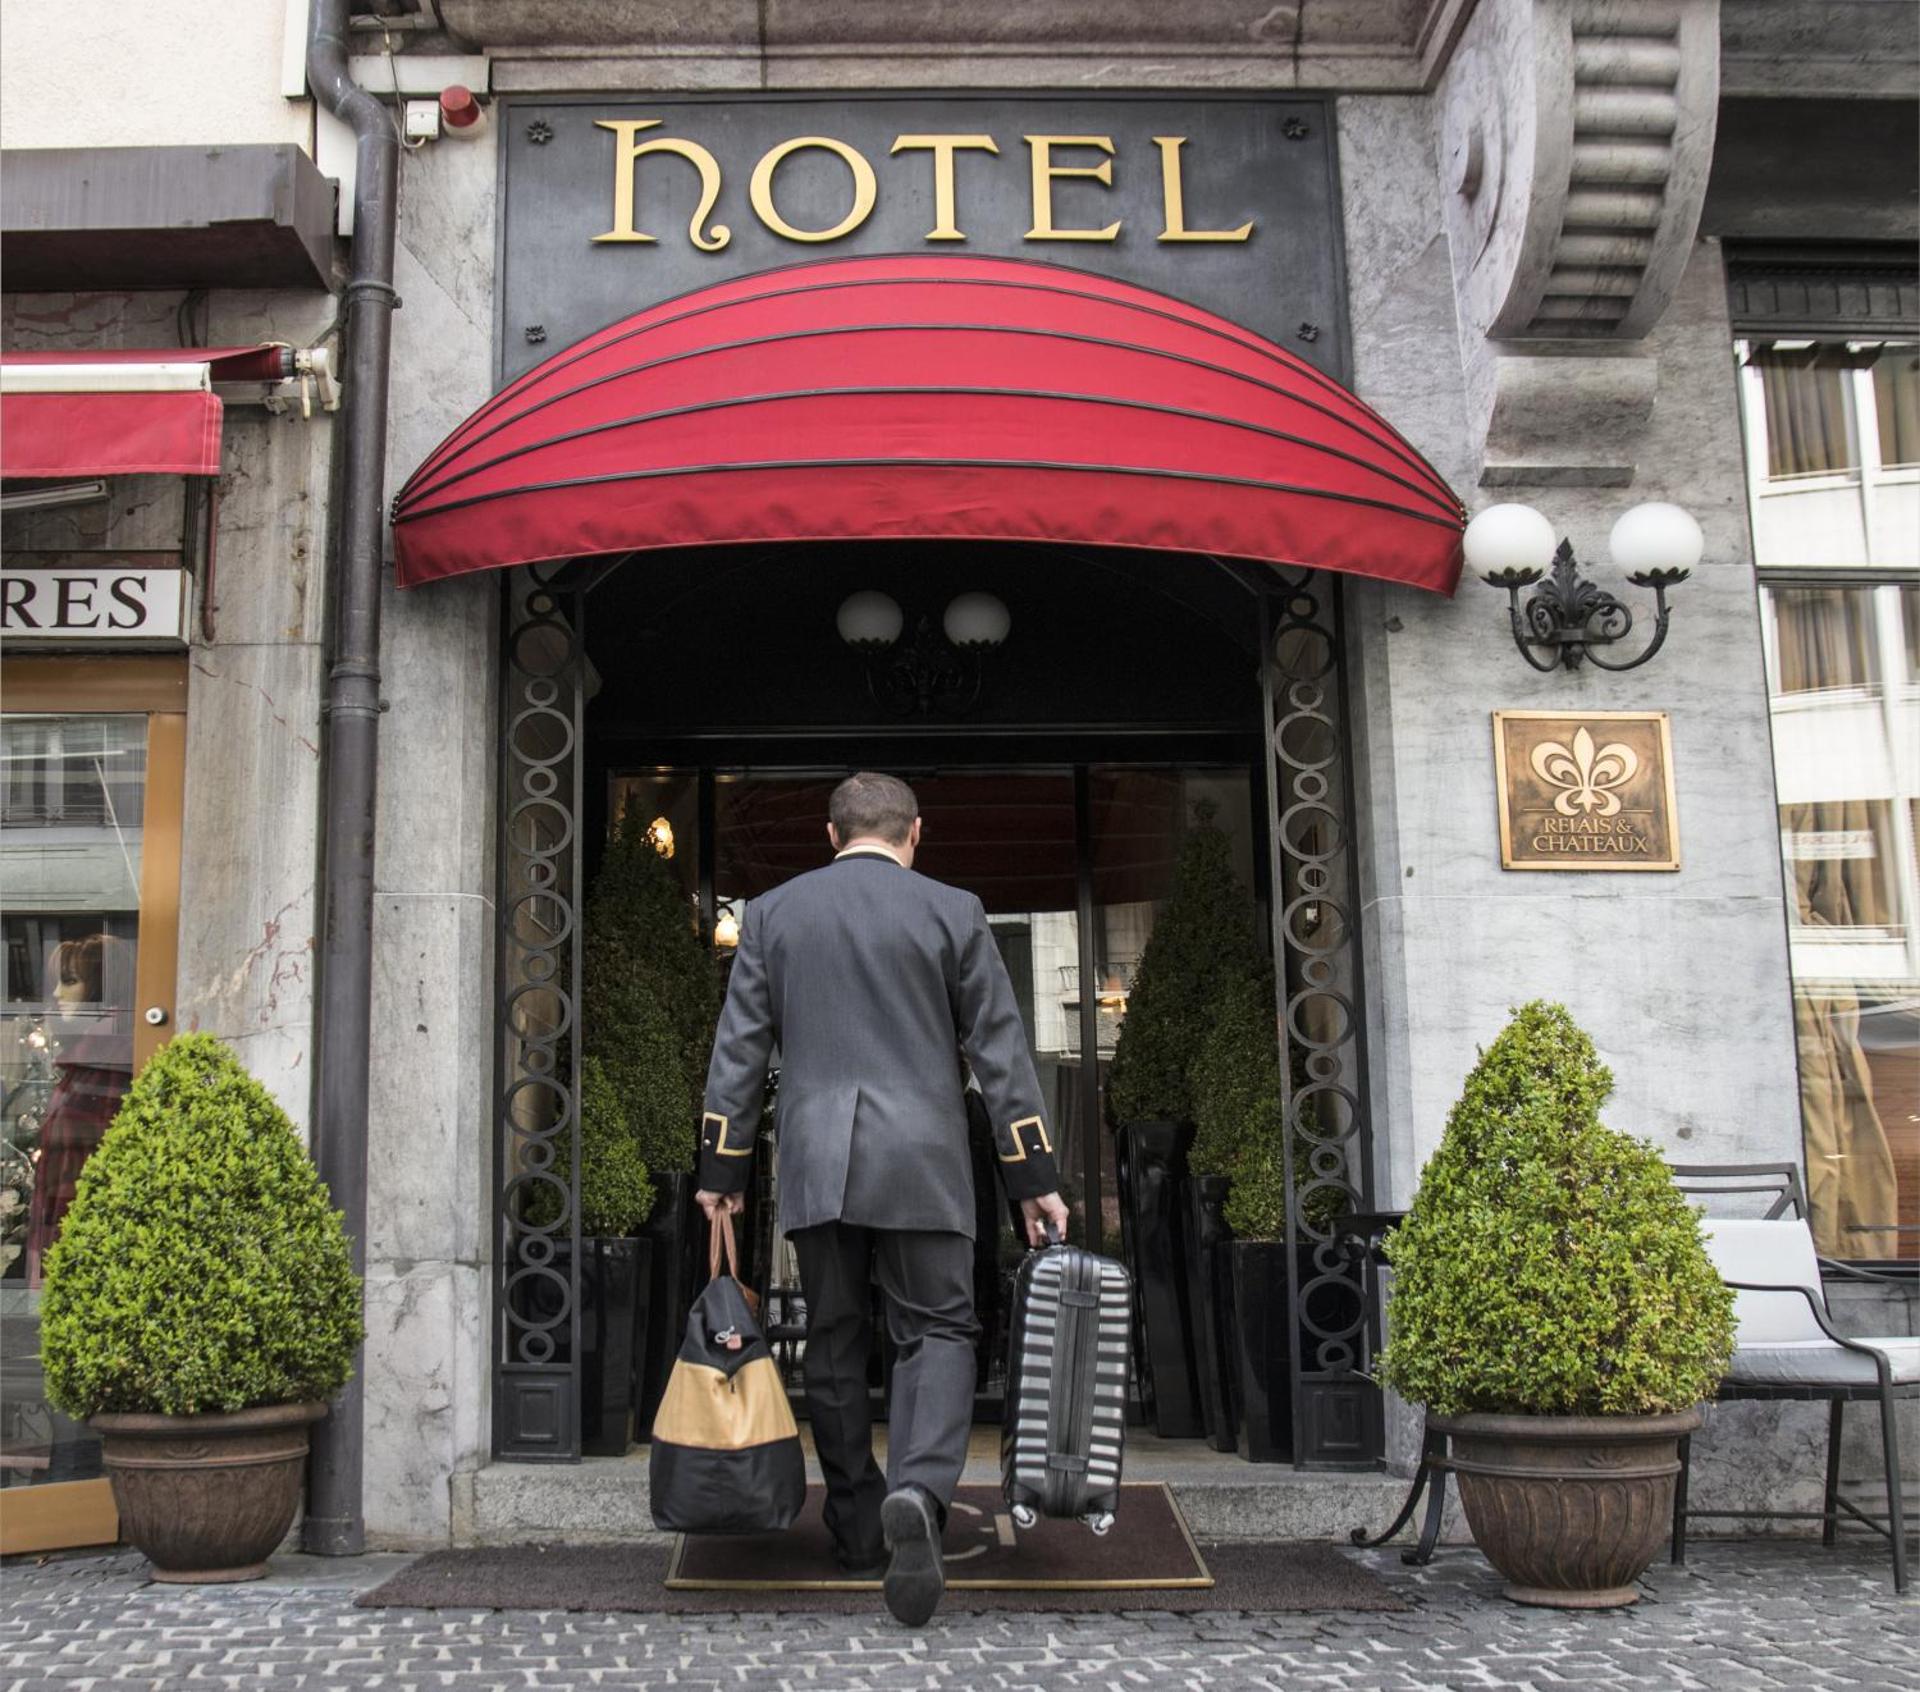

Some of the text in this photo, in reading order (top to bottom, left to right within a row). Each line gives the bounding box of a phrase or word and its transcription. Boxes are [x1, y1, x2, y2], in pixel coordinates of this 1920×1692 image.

[0, 576, 147, 629] RES
[1543, 817, 1633, 834] RELAIS &
[1532, 835, 1648, 852] CHATEAUX
